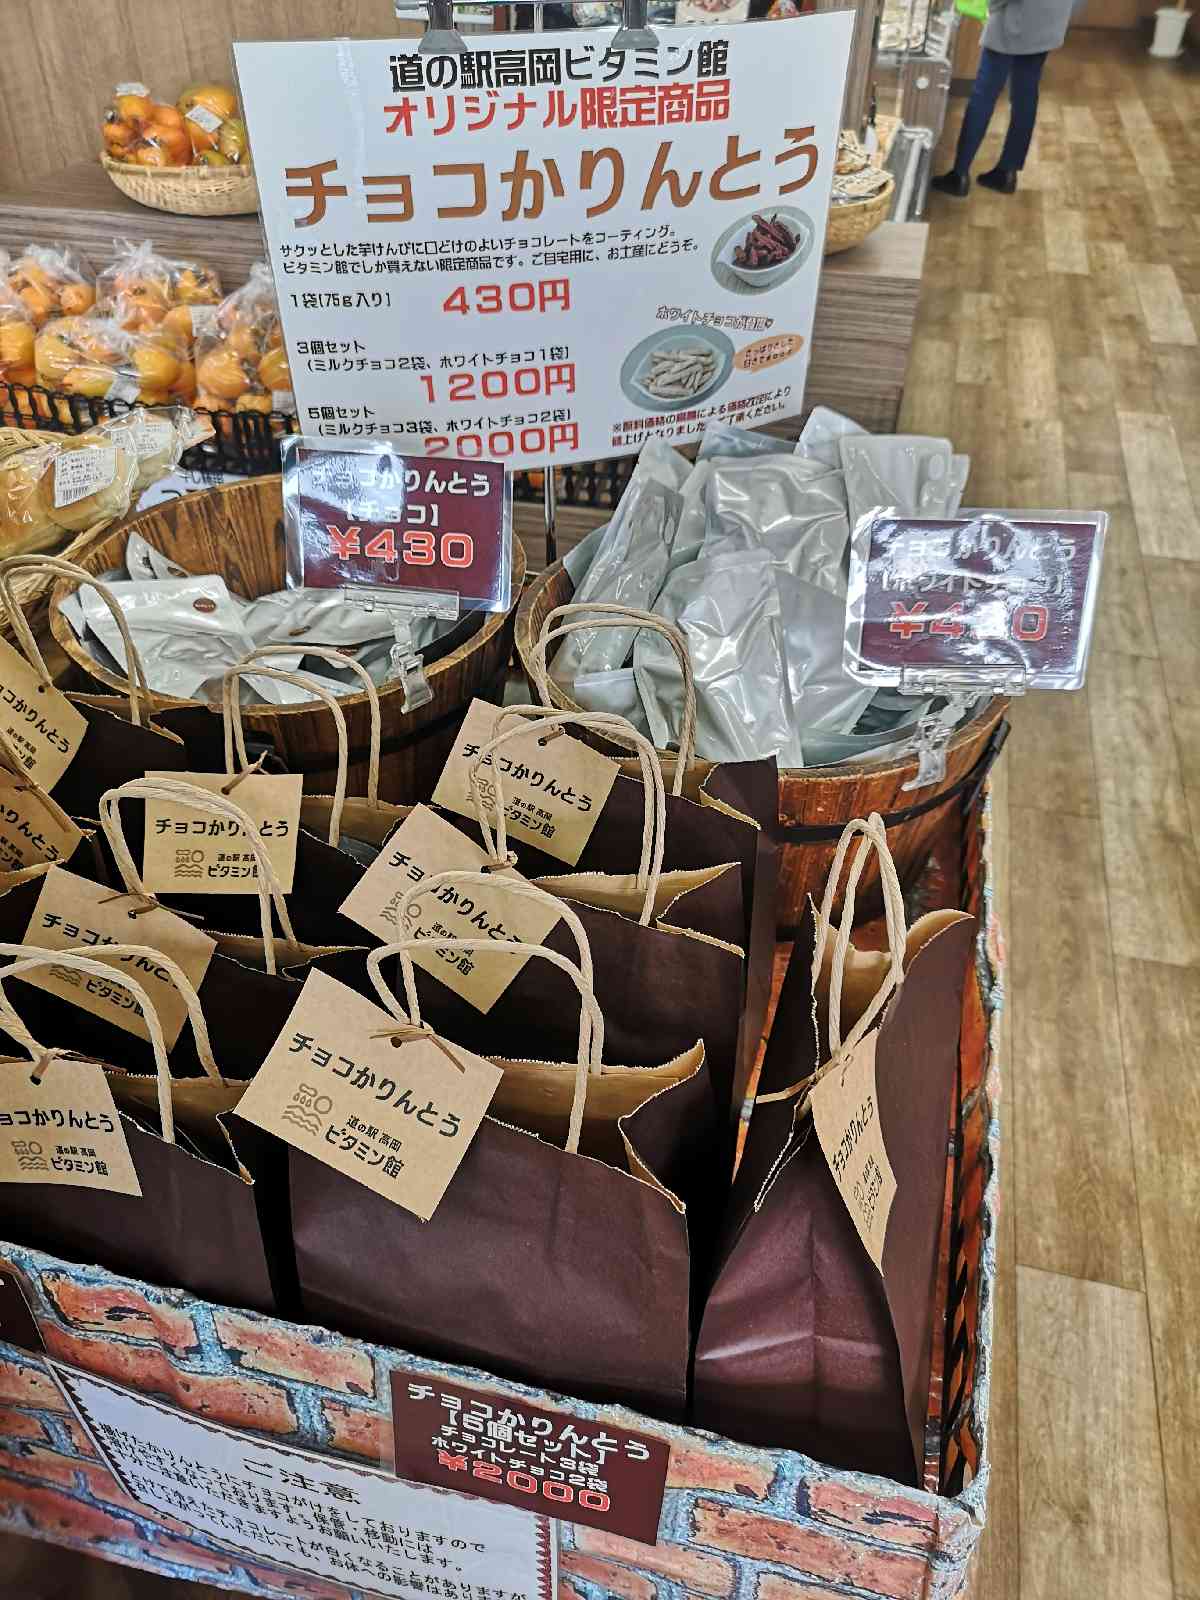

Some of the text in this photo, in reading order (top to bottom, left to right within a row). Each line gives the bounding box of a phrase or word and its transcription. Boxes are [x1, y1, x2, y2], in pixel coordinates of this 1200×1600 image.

[388, 39, 729, 93] 道の駅高岡ビタミン館
[383, 78, 730, 137] オリジナル限定商品
[284, 126, 818, 229] チョコかりんとう
[442, 278, 571, 316] 430円
[296, 340, 366, 355] 3個セット
[420, 363, 576, 403] 1200円
[308, 405, 375, 420] 5個セット
[424, 422, 579, 458] 2000円
[327, 525, 474, 568] ¥430
[888, 601, 1050, 642] ¥40
[155, 818, 289, 837] チョコかりとう
[389, 851, 523, 954] チョかりんと
[288, 1032, 462, 1138] チョコかりんとう
[345, 1114, 380, 1138] 道の駅
[324, 1124, 405, 1179] ビタミン館
[407, 1382, 651, 1460] チョコかりんとう
[242, 1456, 361, 1505] ご注意
[431, 1436, 608, 1493] ホワイトチョコ2袋
[437, 1450, 611, 1512] ¥2000
